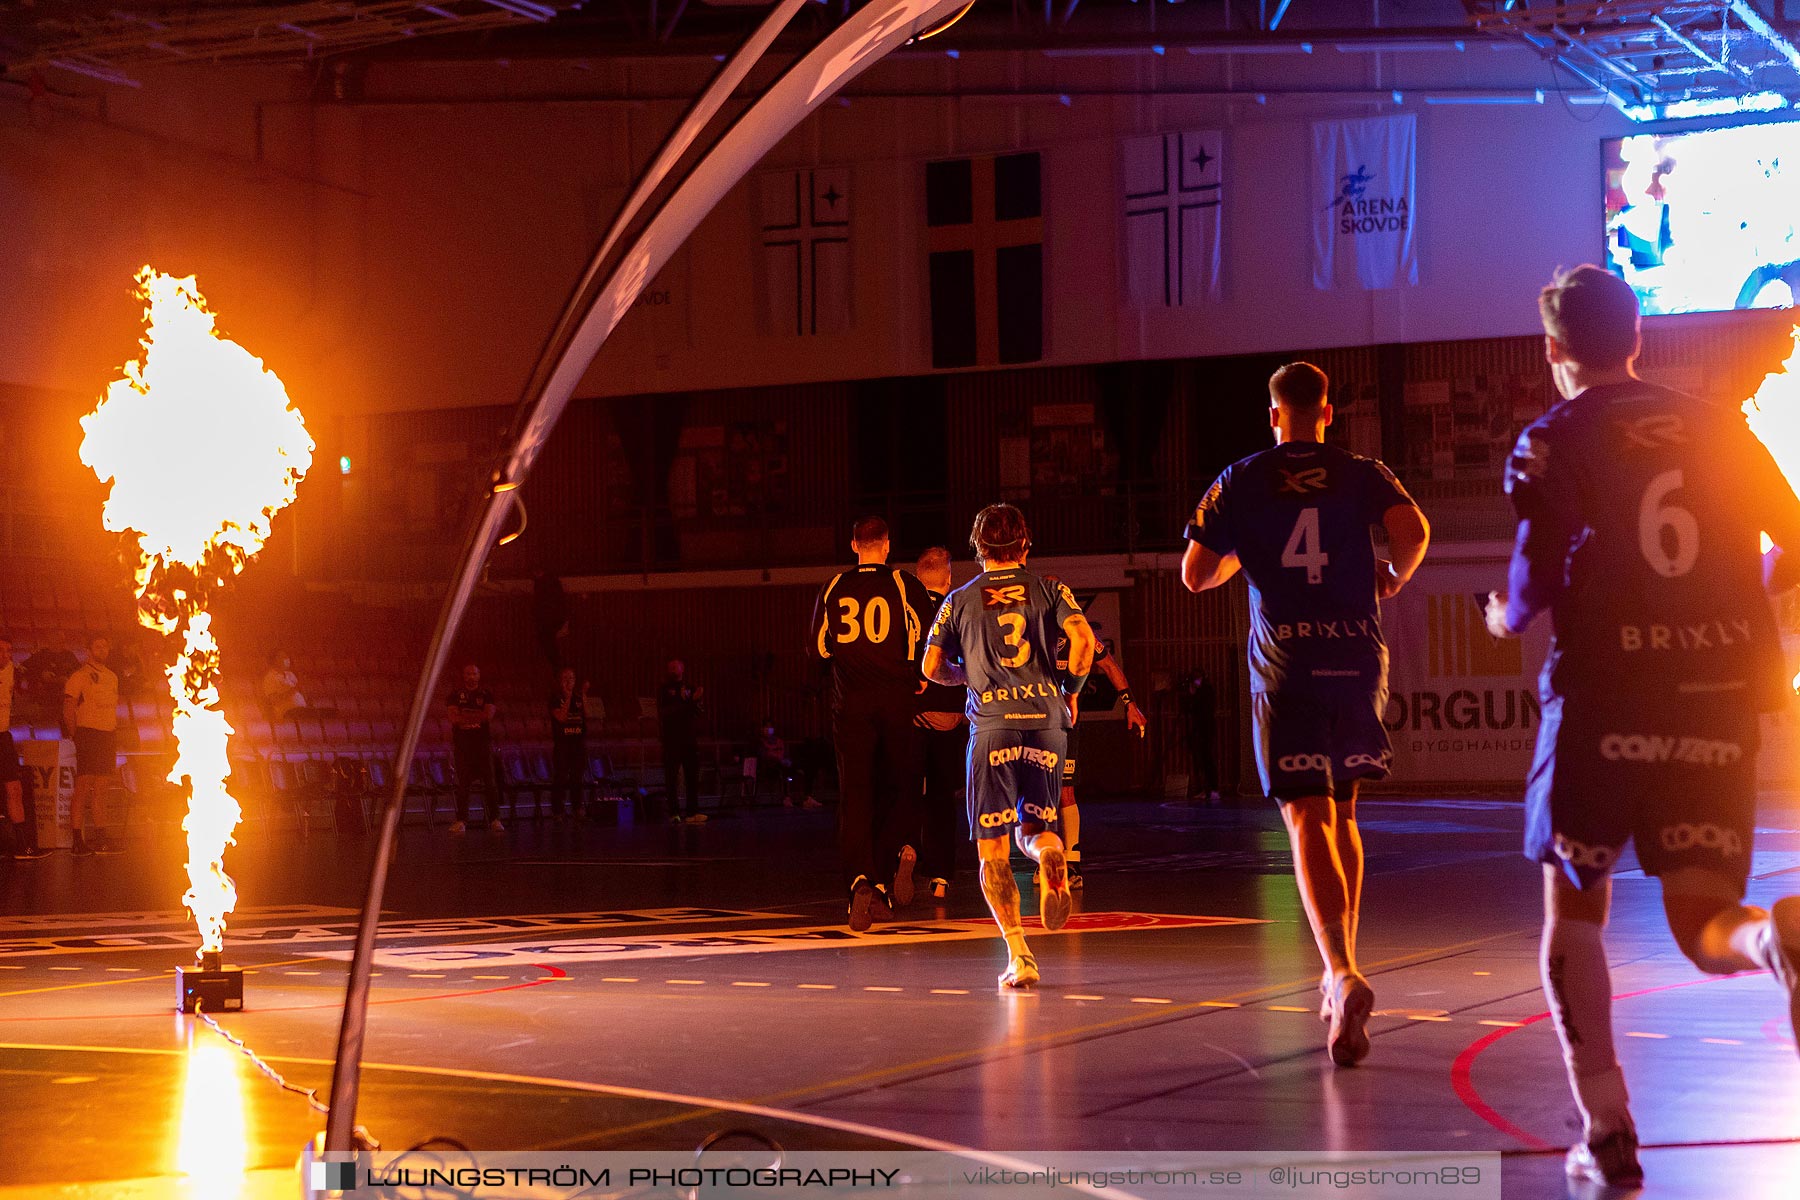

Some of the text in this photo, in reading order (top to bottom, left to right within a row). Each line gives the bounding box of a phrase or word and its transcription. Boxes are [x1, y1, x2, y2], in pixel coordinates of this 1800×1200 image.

[1342, 197, 1408, 216] ARENA
[1341, 215, 1408, 235] SKÖVDE
[1279, 467, 1328, 493] XR
[1638, 469, 1700, 578] 6
[1281, 507, 1329, 584] 4
[984, 585, 1026, 606] XR
[837, 596, 890, 644] 30
[1277, 619, 1369, 641] BRIXLY
[997, 612, 1031, 668] 3
[1620, 620, 1749, 651] BRIXLY
[982, 682, 1058, 704] BRIXLY
